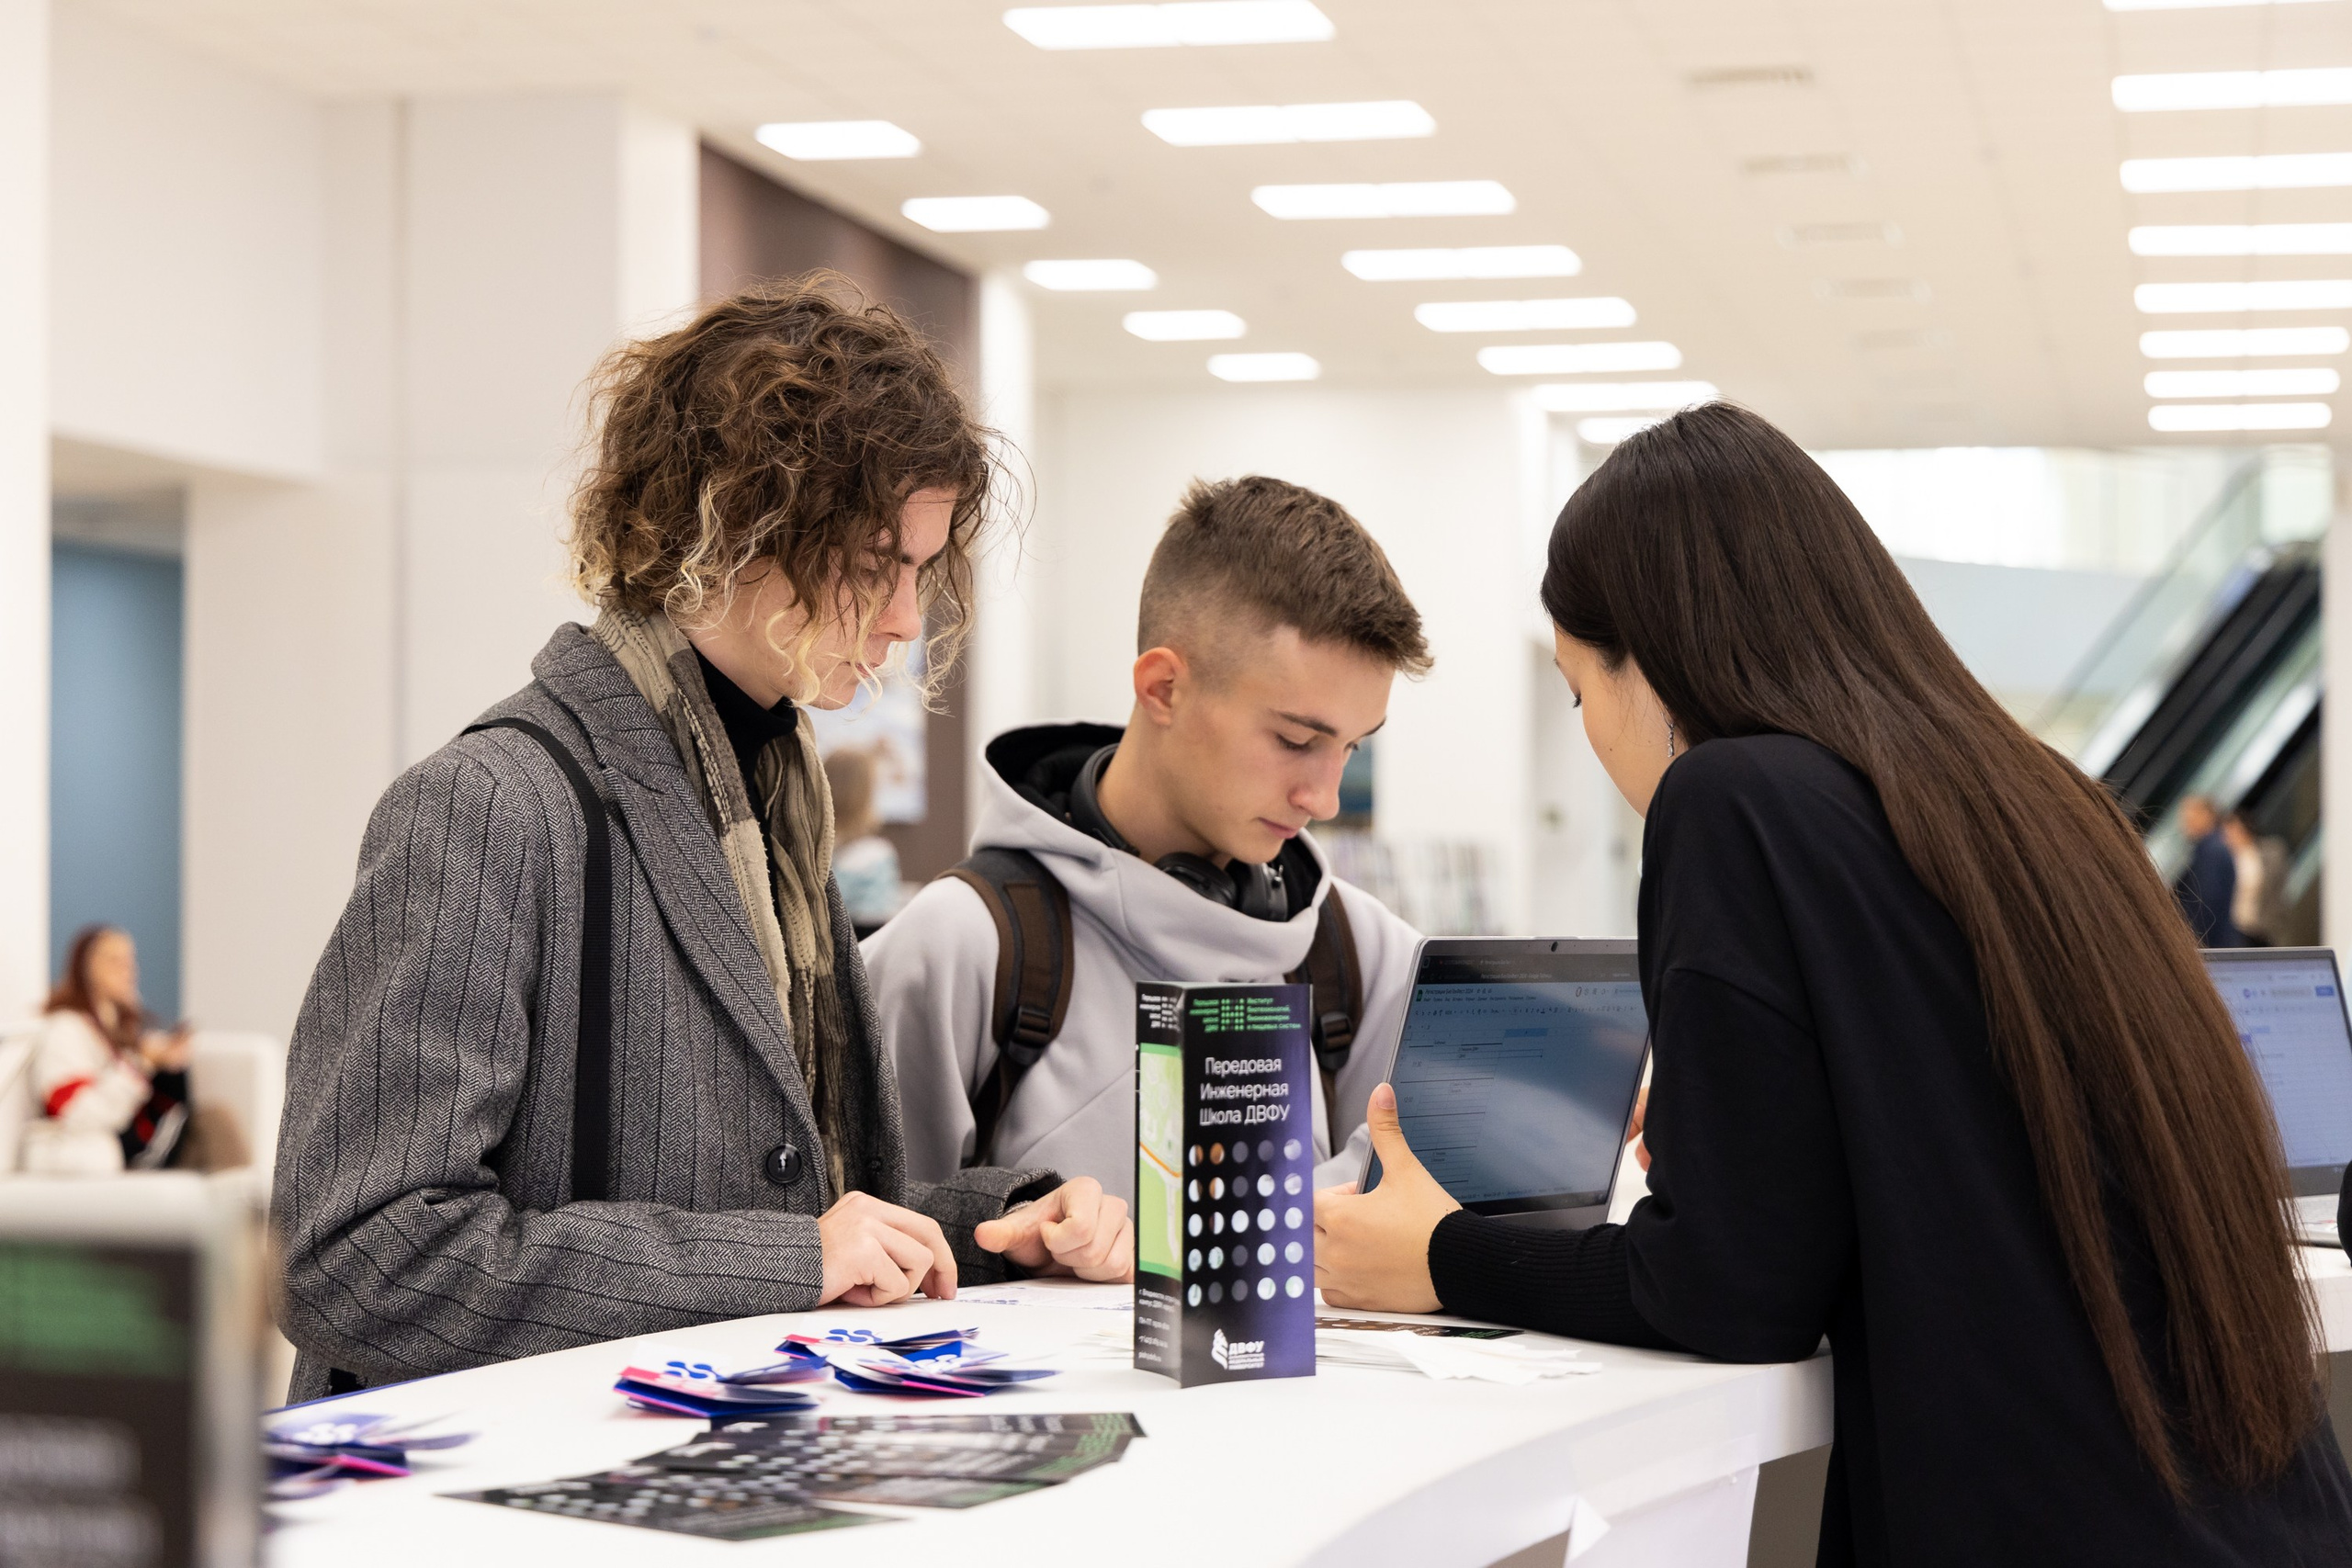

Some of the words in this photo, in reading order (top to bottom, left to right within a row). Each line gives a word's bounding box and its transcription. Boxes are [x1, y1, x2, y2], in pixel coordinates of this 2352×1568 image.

[1204, 1057, 1283, 1078] Передовая
[1199, 1081, 1289, 1101] Инженерная
[1198, 1107, 1242, 1126] Школа
[1244, 1103, 1291, 1125] ДВФУ
[1228, 1340, 1265, 1356] ДВФУ
